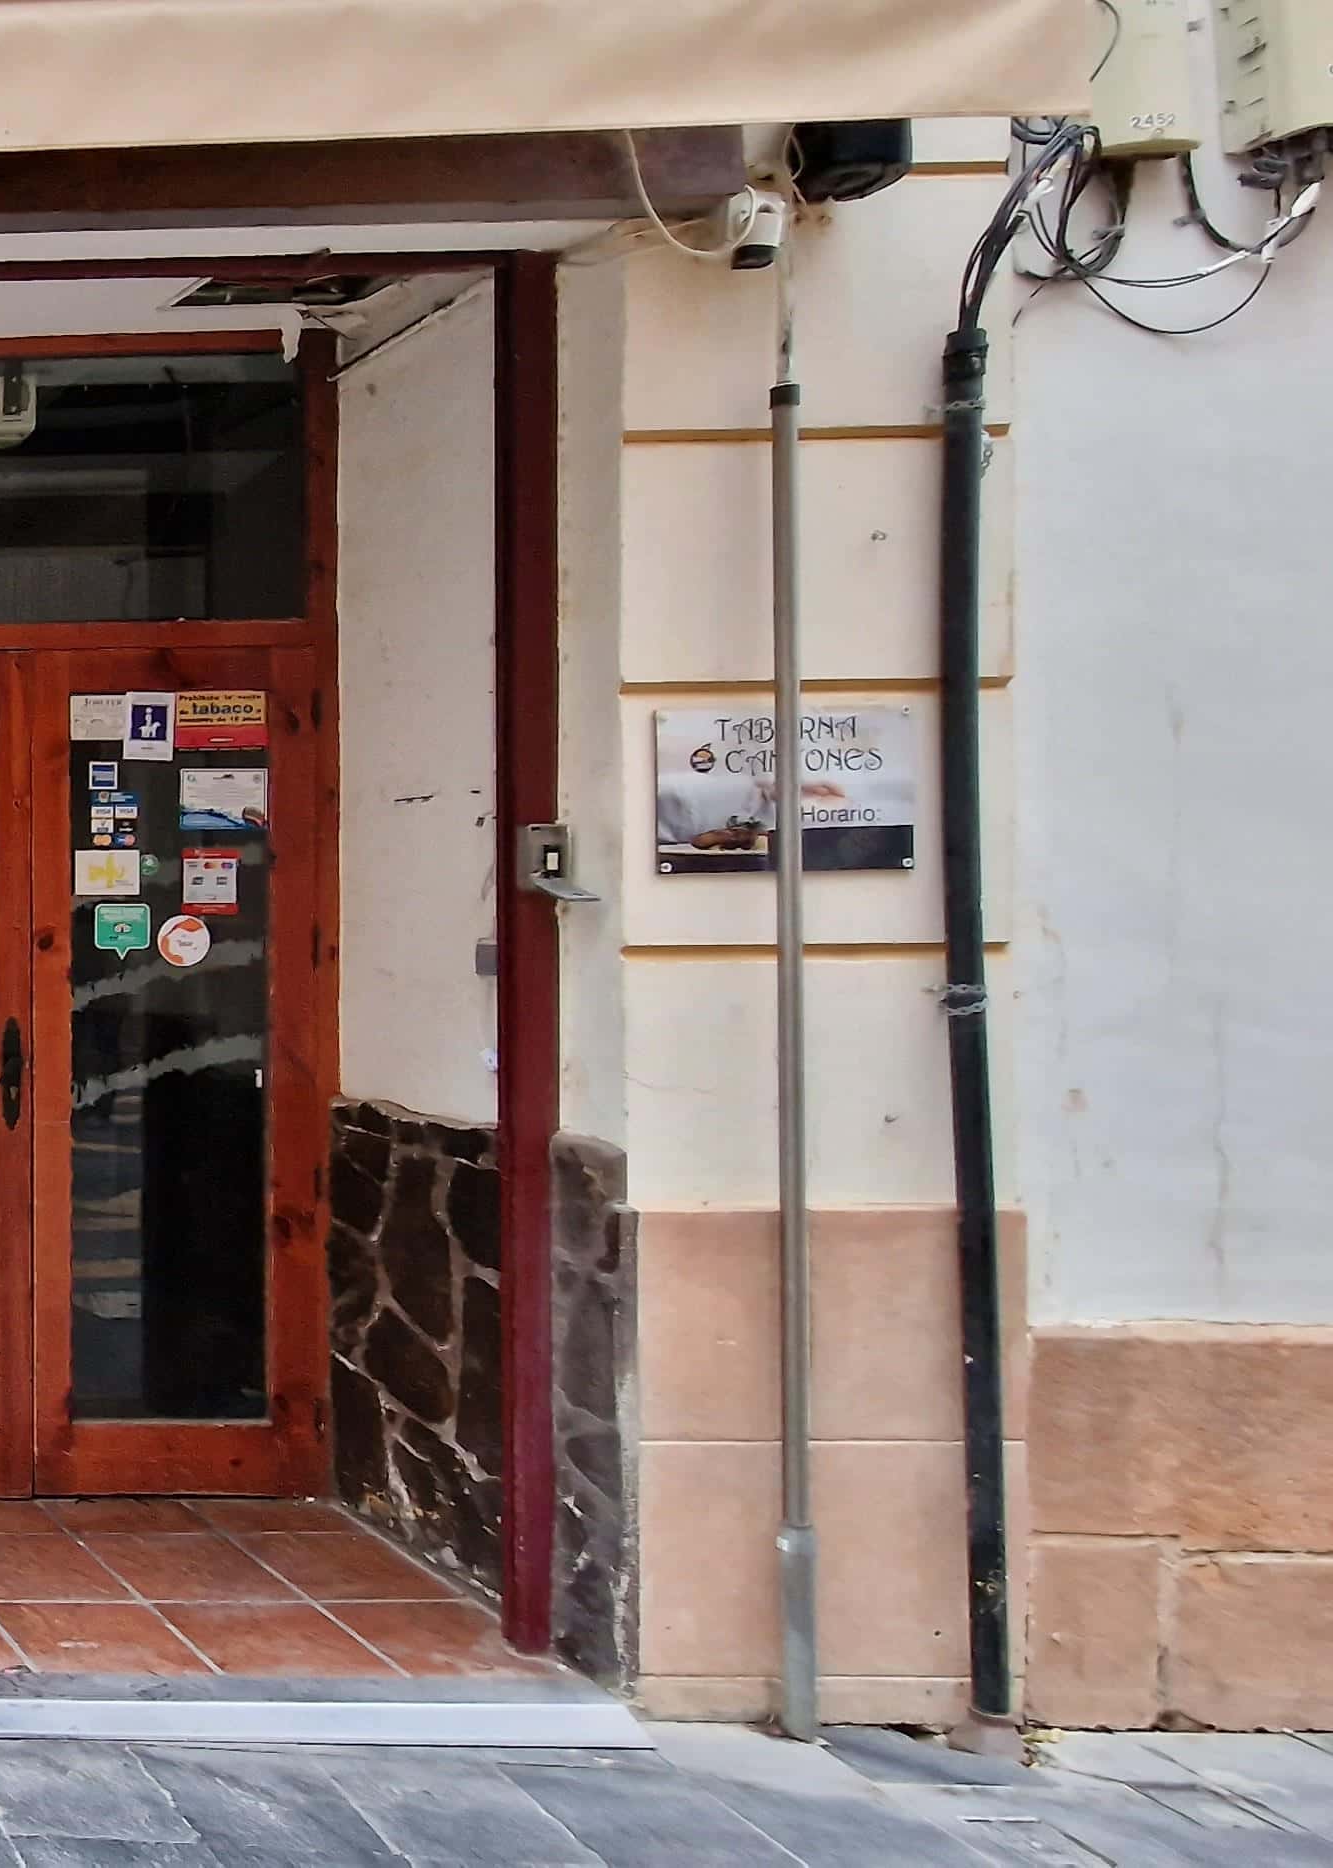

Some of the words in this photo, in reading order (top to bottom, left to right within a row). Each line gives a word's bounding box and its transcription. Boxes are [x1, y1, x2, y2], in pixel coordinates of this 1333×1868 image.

[1131, 113, 1175, 129] 2452
[192, 702, 254, 715] tabaco
[714, 715, 857, 744] TABRNA
[725, 748, 884, 776] CAONES
